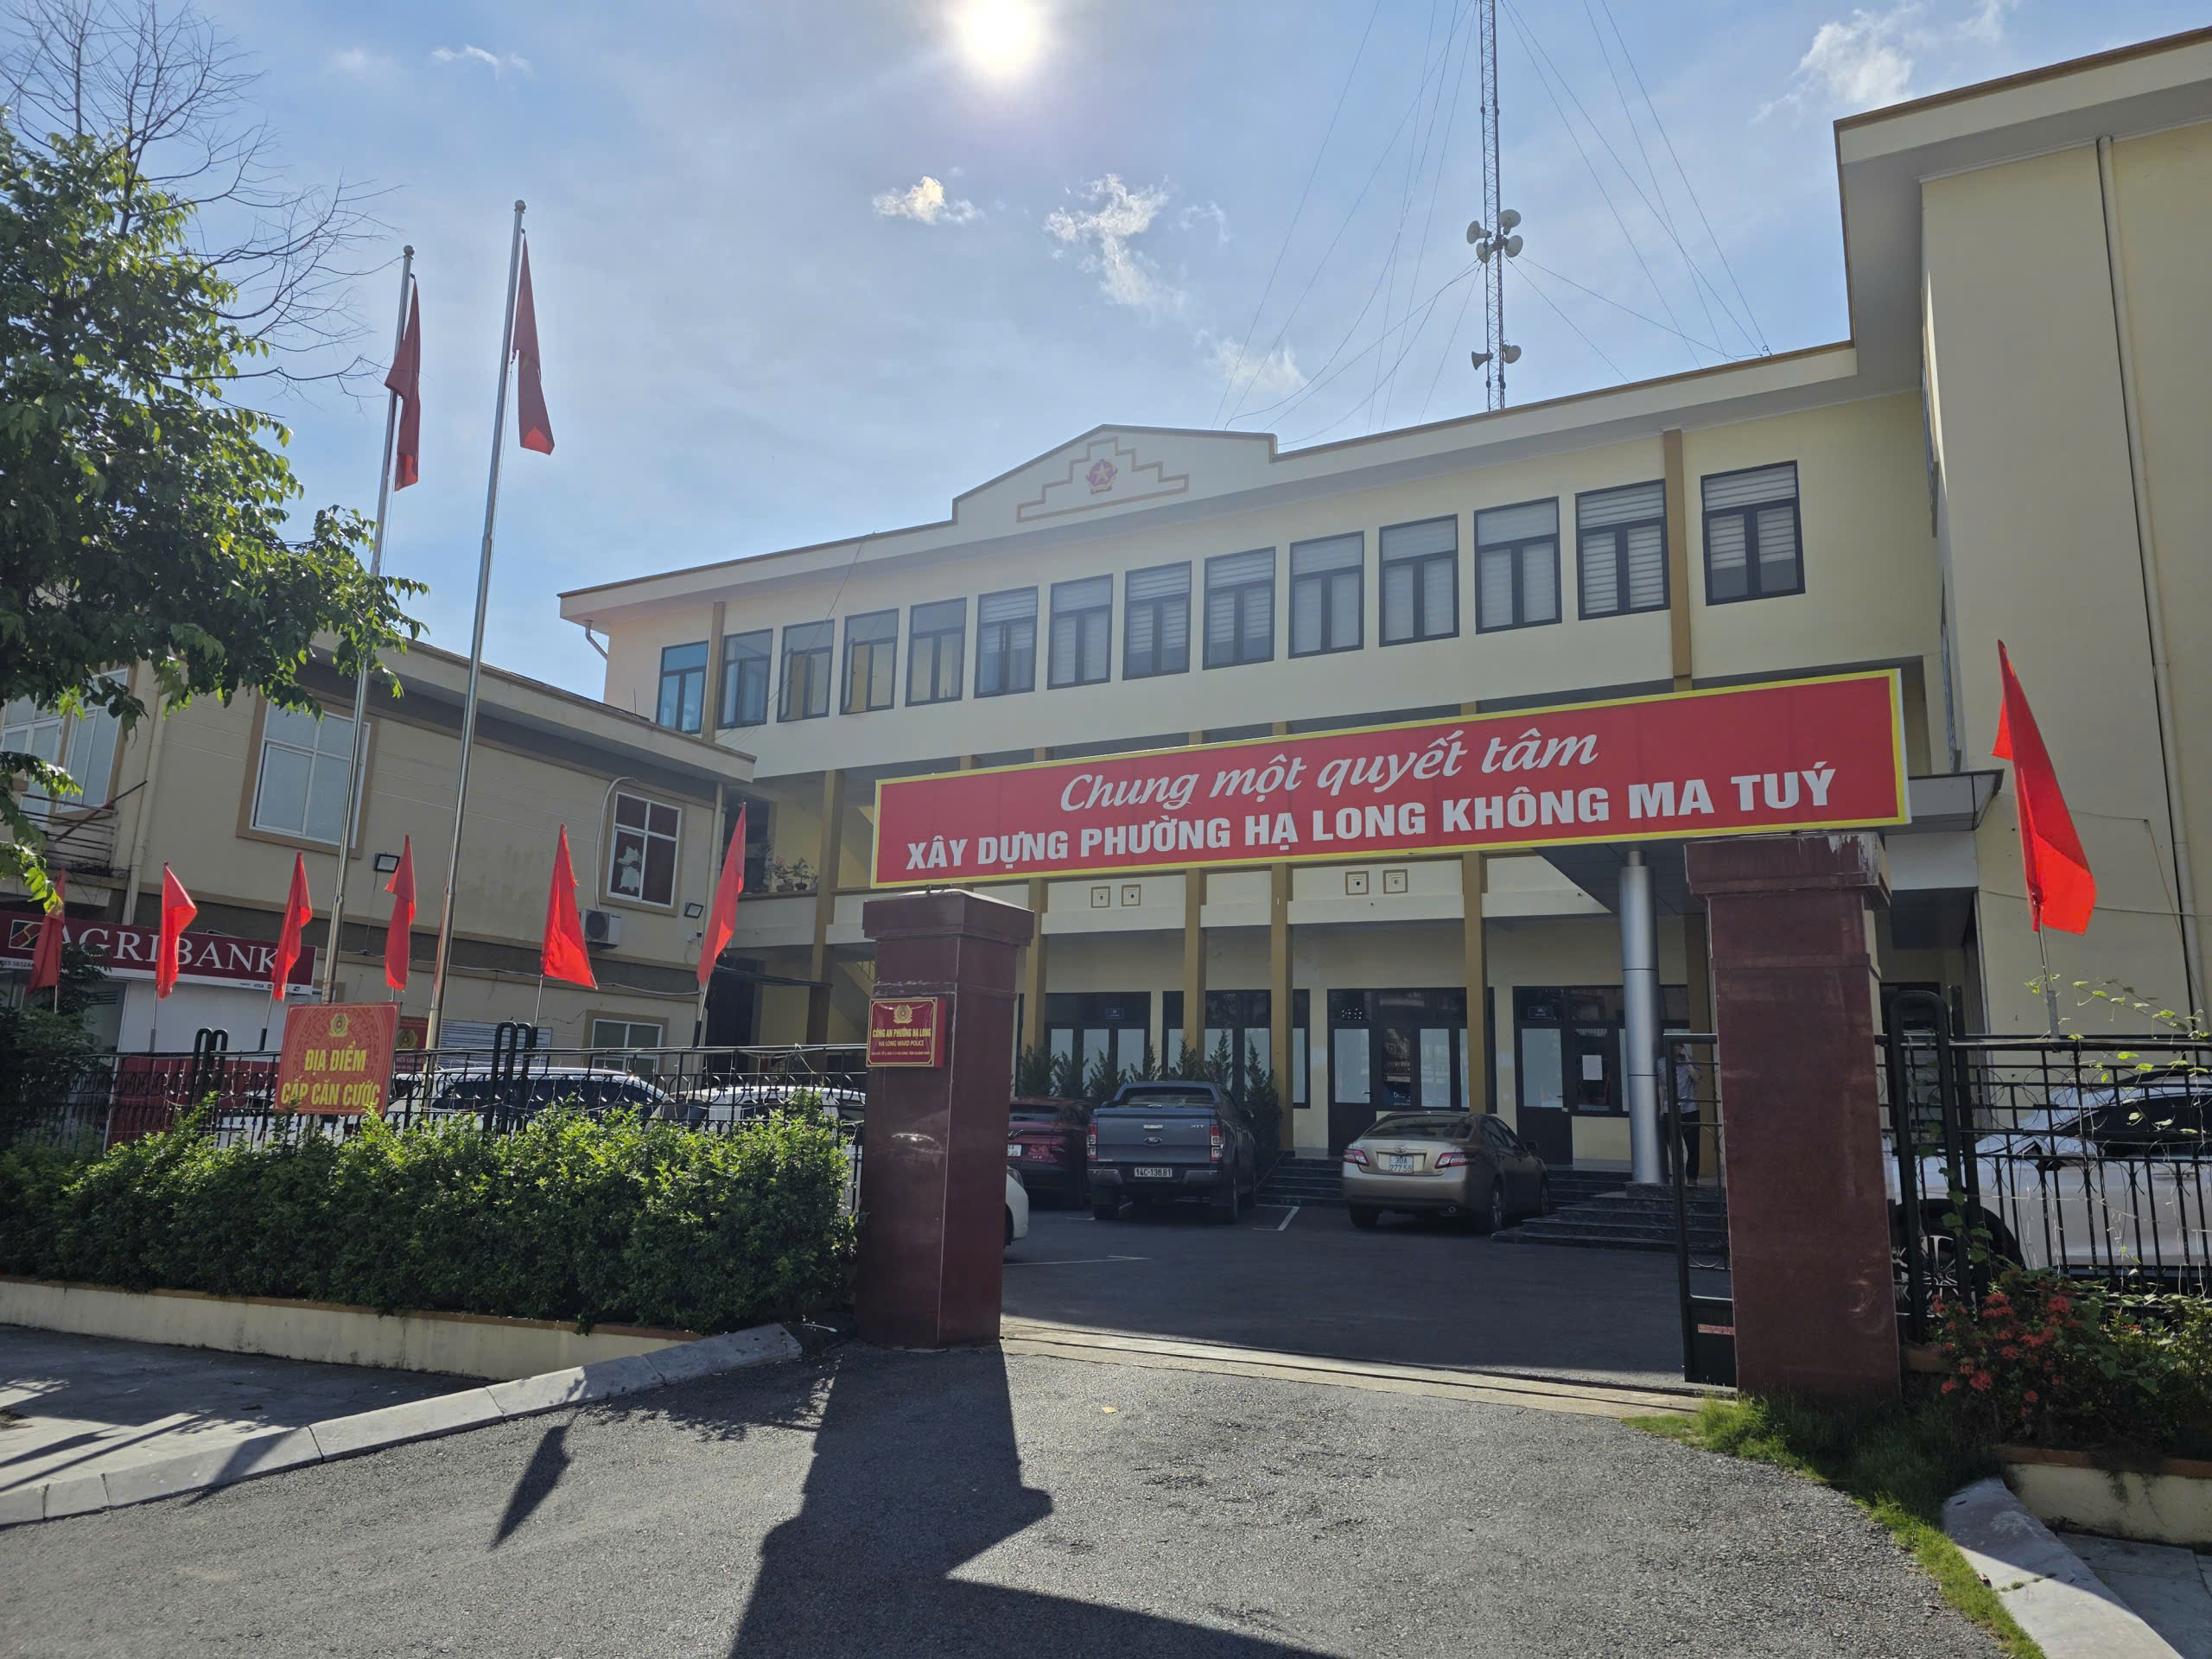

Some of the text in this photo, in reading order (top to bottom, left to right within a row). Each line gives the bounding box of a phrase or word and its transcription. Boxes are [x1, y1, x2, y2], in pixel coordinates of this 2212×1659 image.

[1061, 727, 1599, 812] Chung một quyết tâm
[906, 760, 1836, 870] XÂY DỰNG PHƯỜNG HẠ LONG KHÔNG MA TUÝ
[872, 1027, 931, 1039] CÔNG AN PHƯỜNG HẠ LONG
[304, 1050, 327, 1077] ĐỊA
[329, 1039, 367, 1072] ĐIỂM
[281, 1075, 381, 1107] CẤP CĂN CƯỚC
